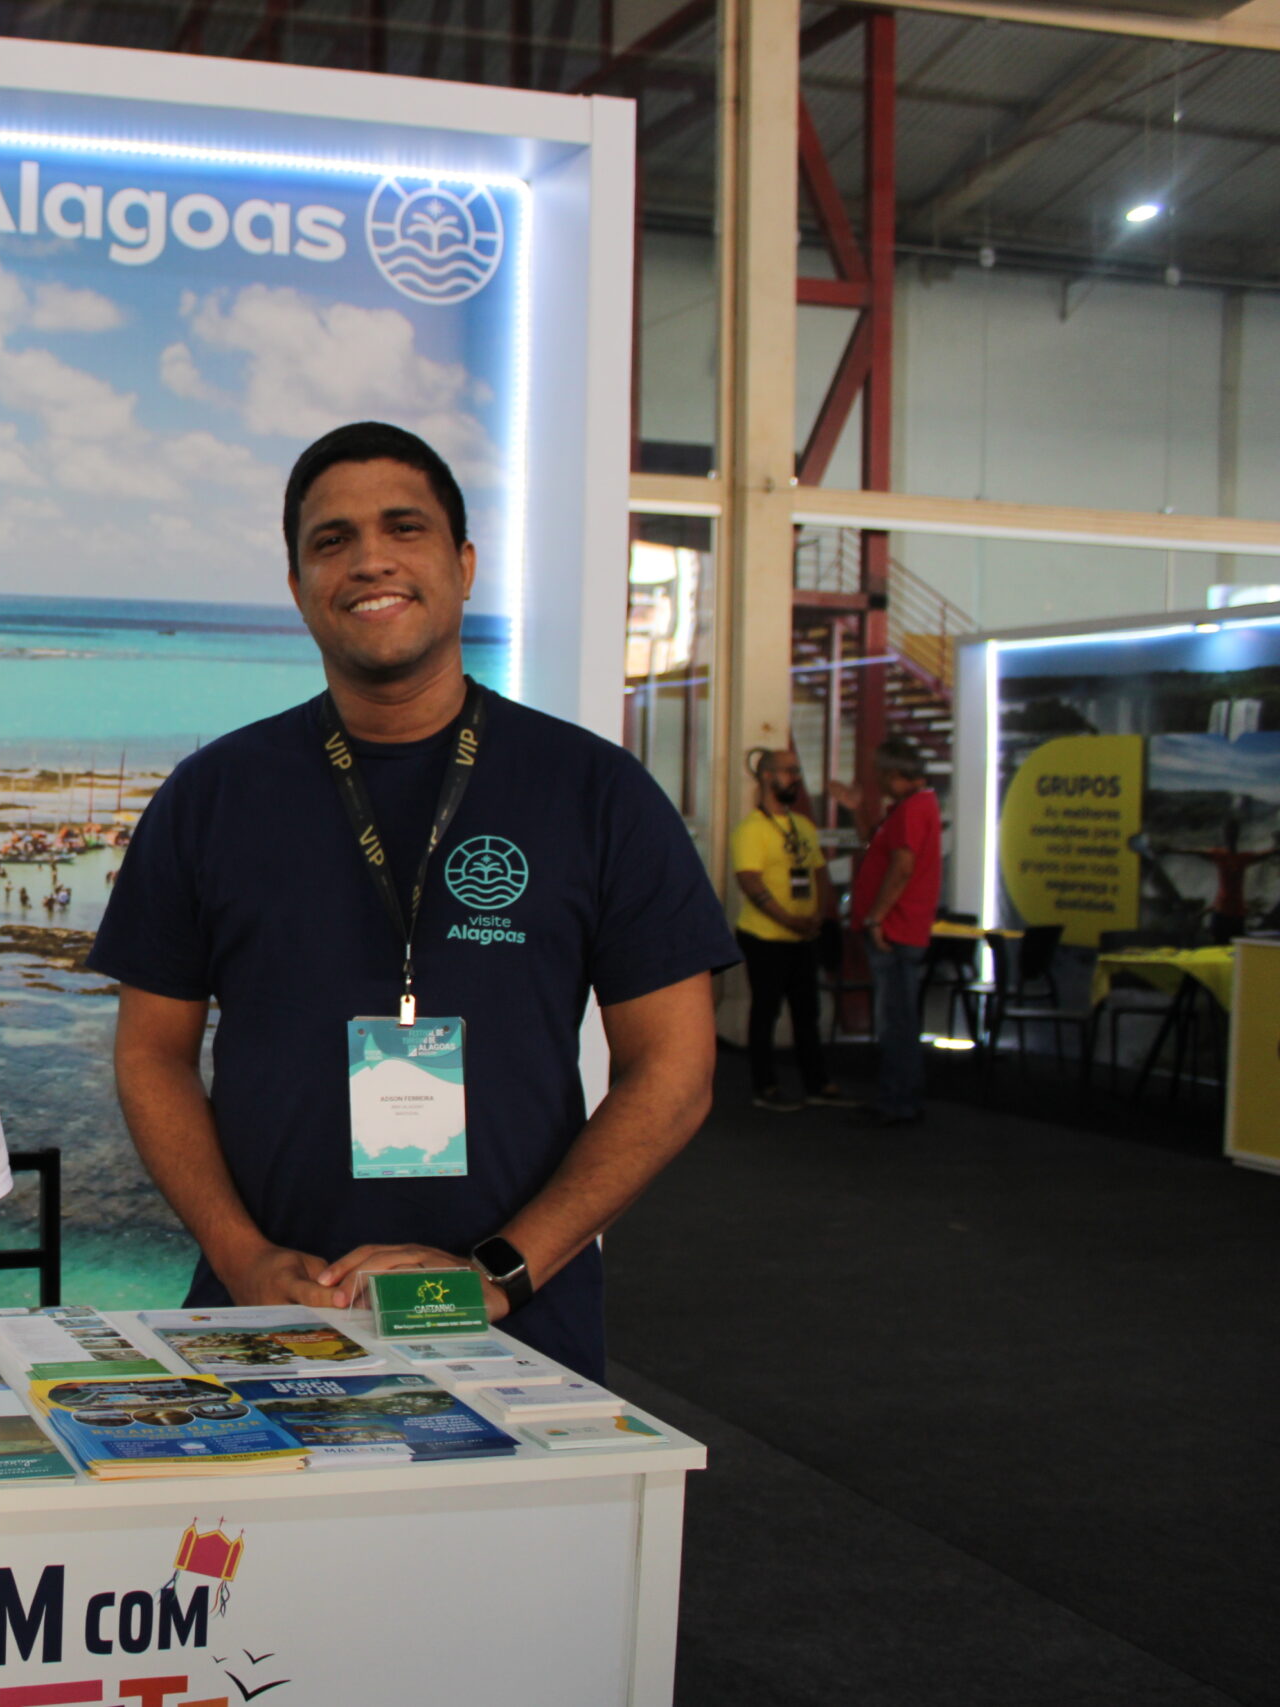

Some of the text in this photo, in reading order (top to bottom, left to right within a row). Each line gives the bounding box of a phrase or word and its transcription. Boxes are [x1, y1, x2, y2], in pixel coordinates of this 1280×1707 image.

[324, 731, 353, 770] VIP
[455, 728, 479, 767] VIP
[1036, 775, 1121, 798] GRUPOS
[359, 824, 385, 866] VIP
[446, 924, 527, 945] Alagoas
[469, 914, 512, 928] visite
[84, 1585, 210, 1655] COM
